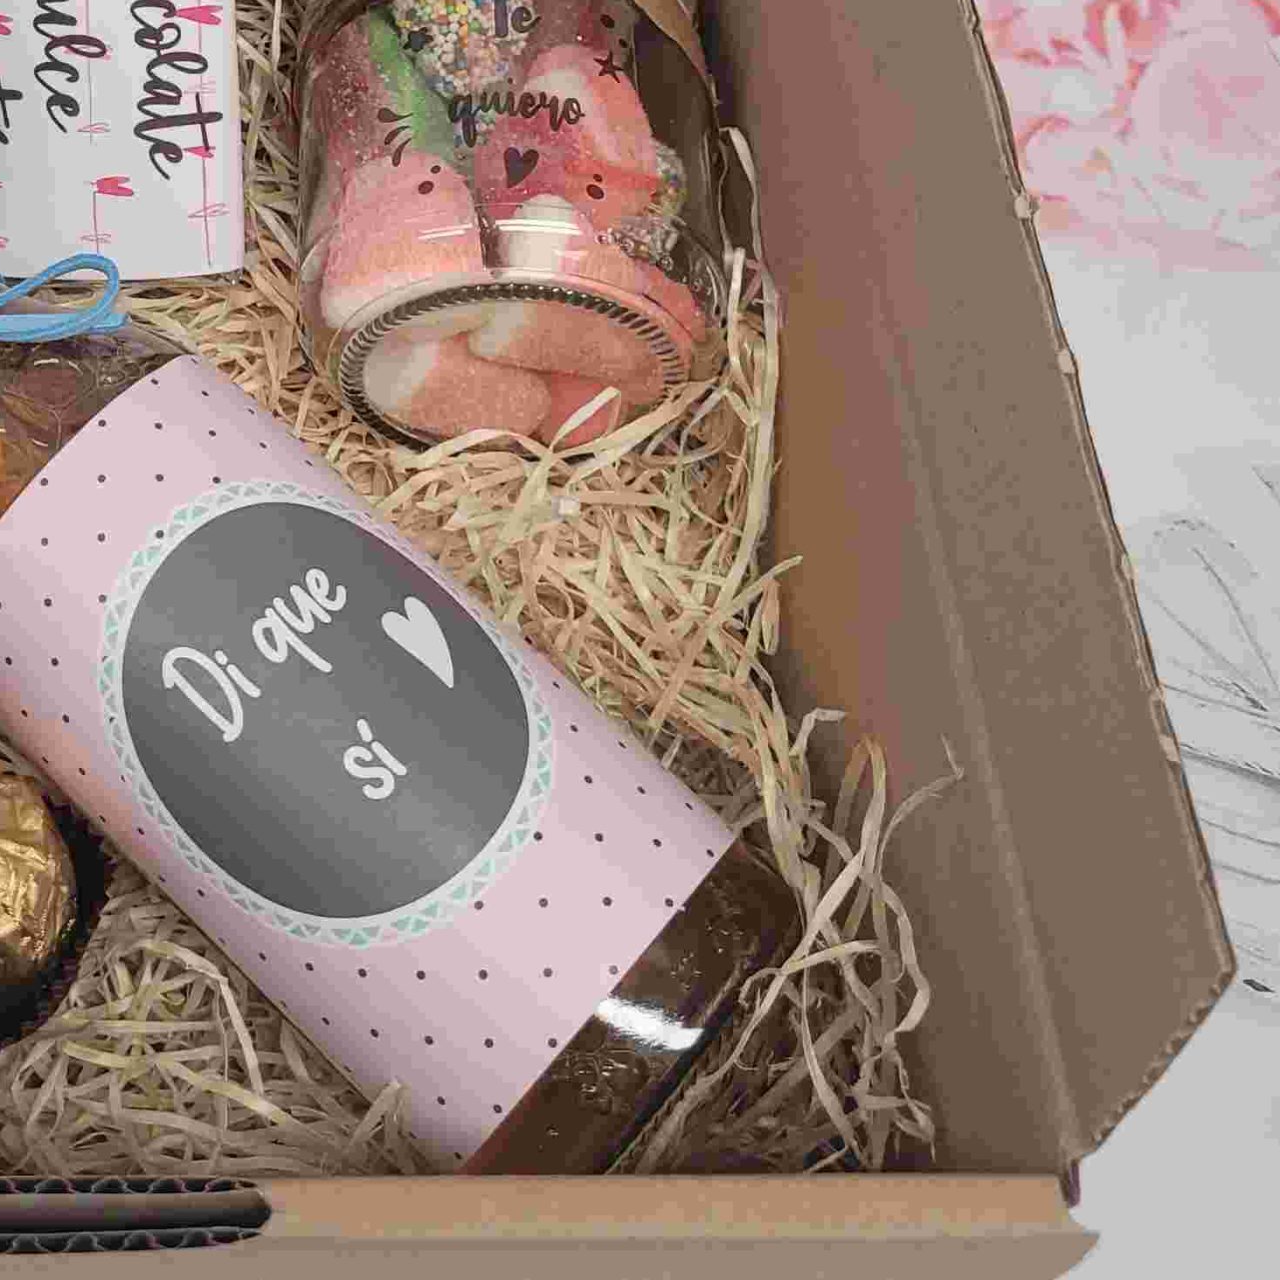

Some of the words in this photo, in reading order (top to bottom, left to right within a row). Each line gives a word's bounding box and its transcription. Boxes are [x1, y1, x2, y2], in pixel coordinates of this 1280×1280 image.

[446, 77, 587, 148] quiero
[161, 646, 263, 744] Di
[252, 567, 348, 674] que
[342, 717, 409, 801] sí
